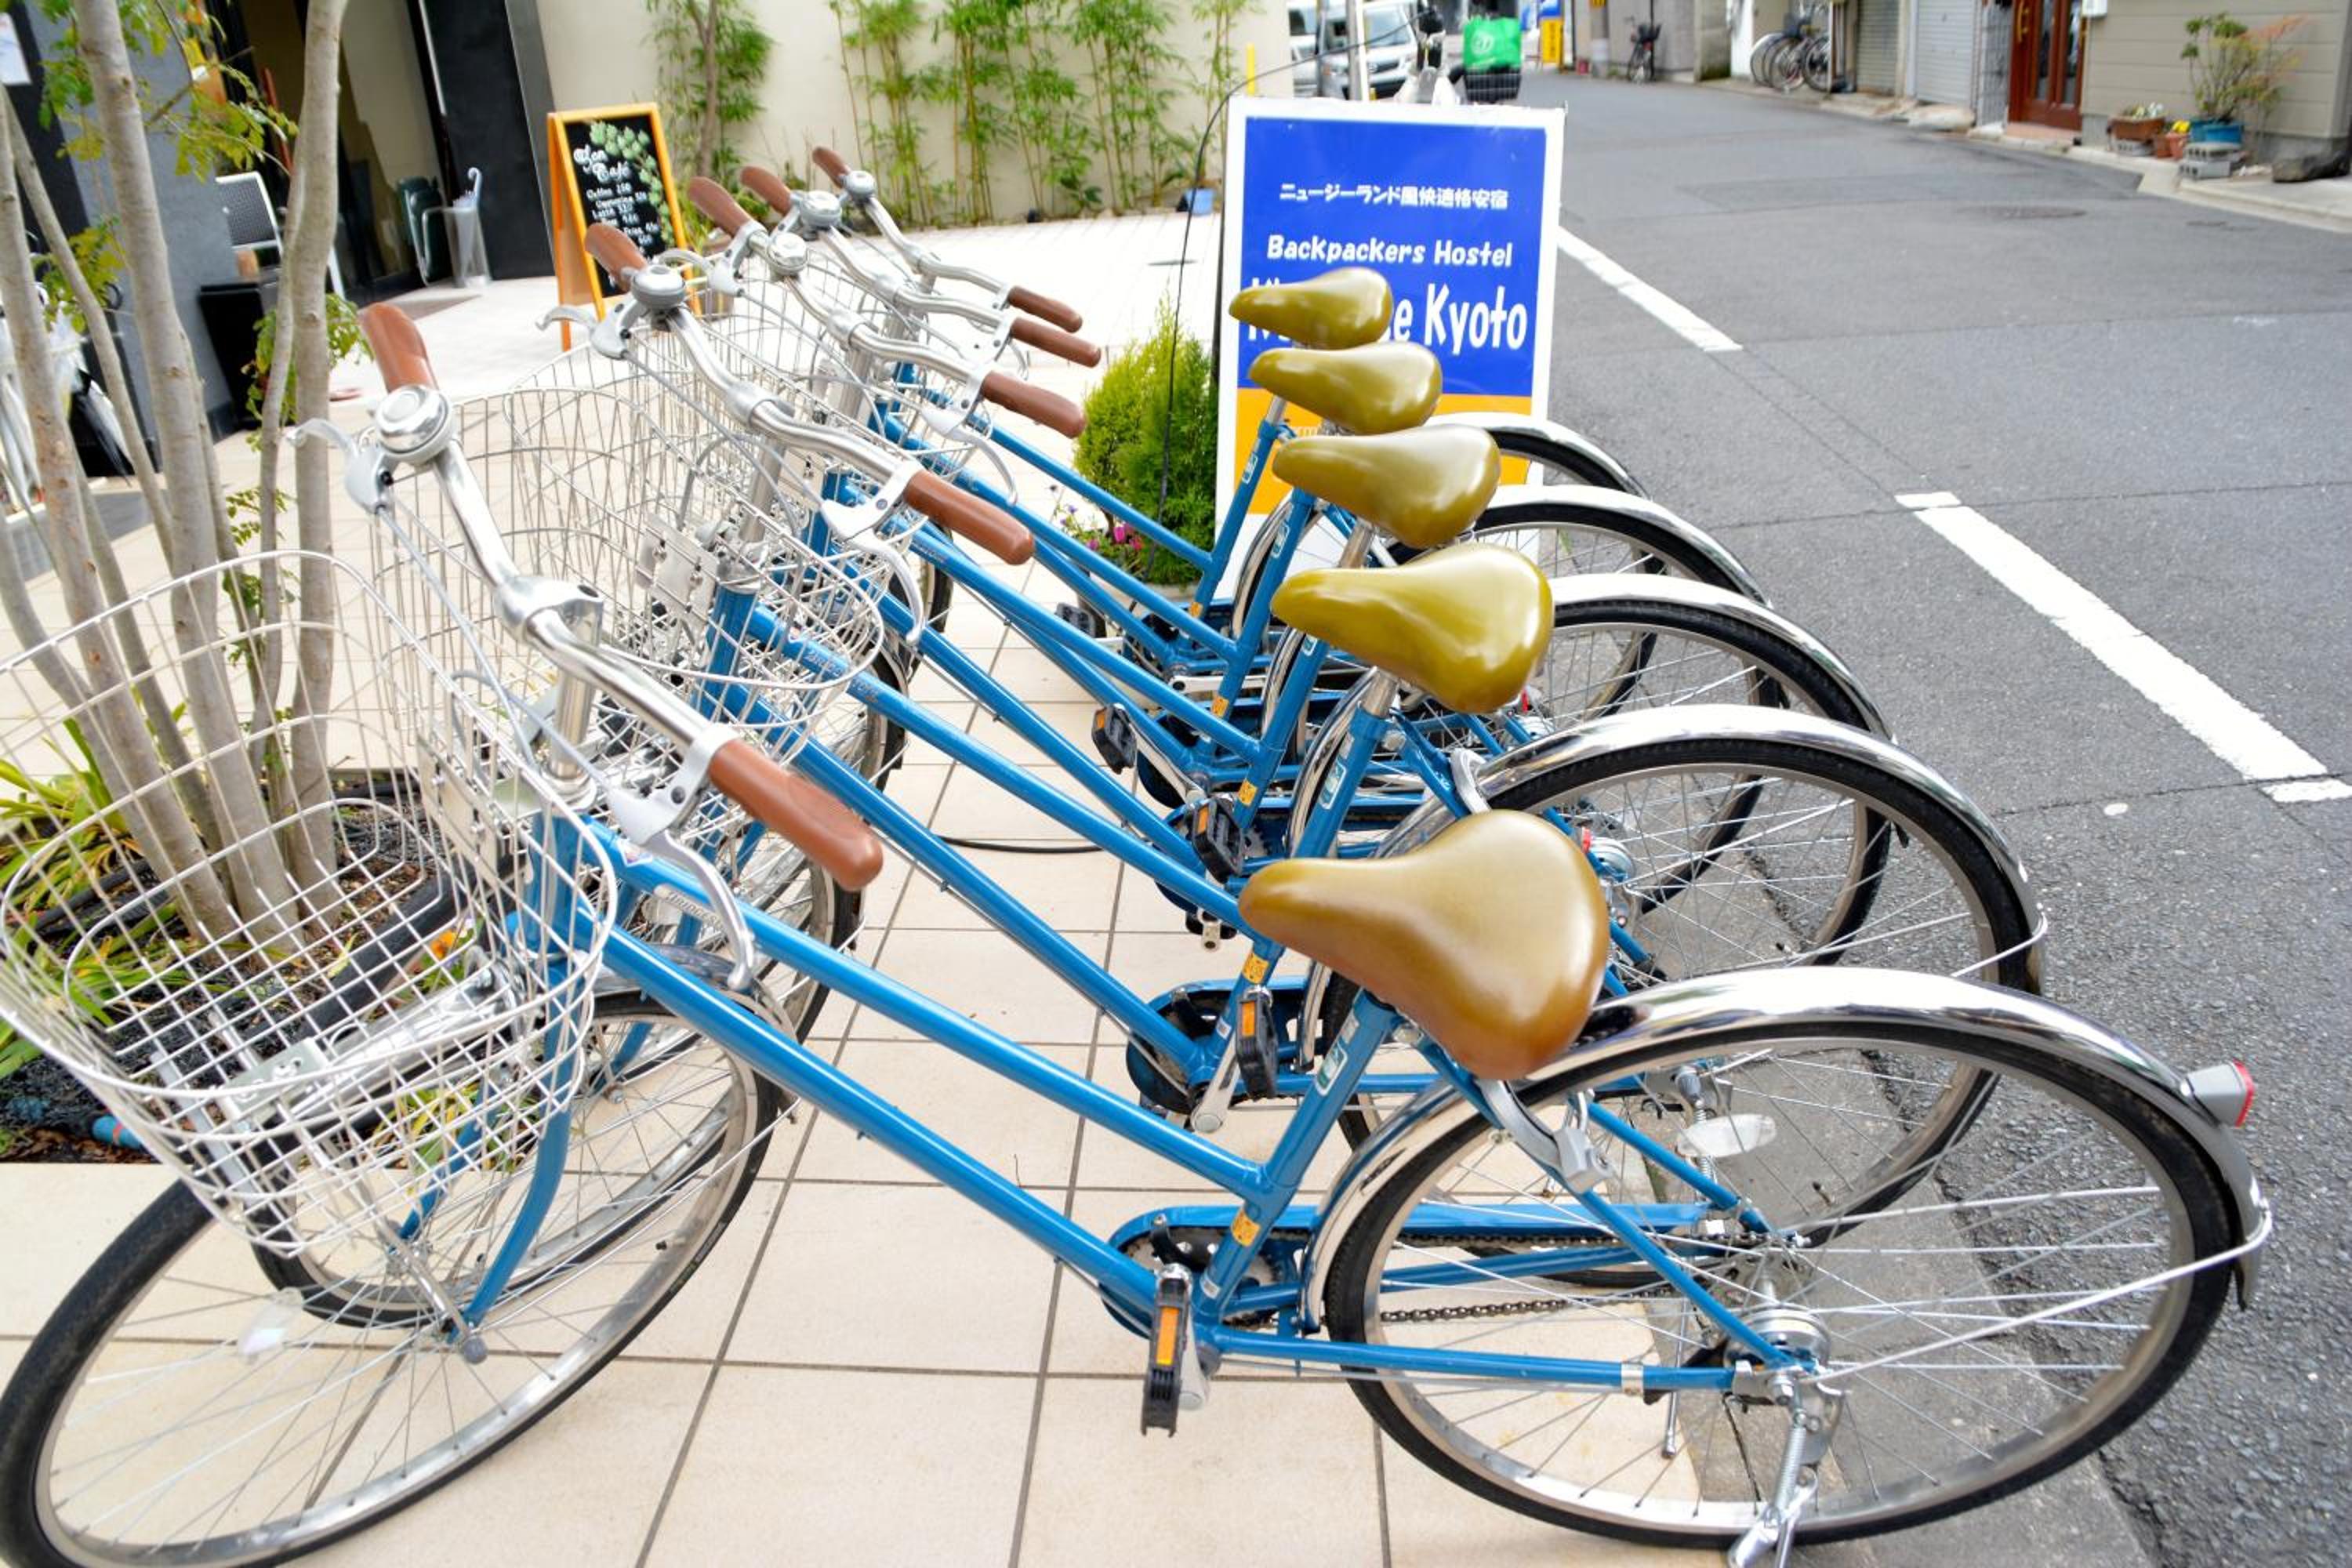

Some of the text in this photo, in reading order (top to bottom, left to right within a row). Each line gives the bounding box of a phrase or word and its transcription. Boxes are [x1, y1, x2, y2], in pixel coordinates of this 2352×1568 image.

[1268, 235, 1512, 267] Backpackers Hostel
[1424, 285, 1526, 356] Kyoto
